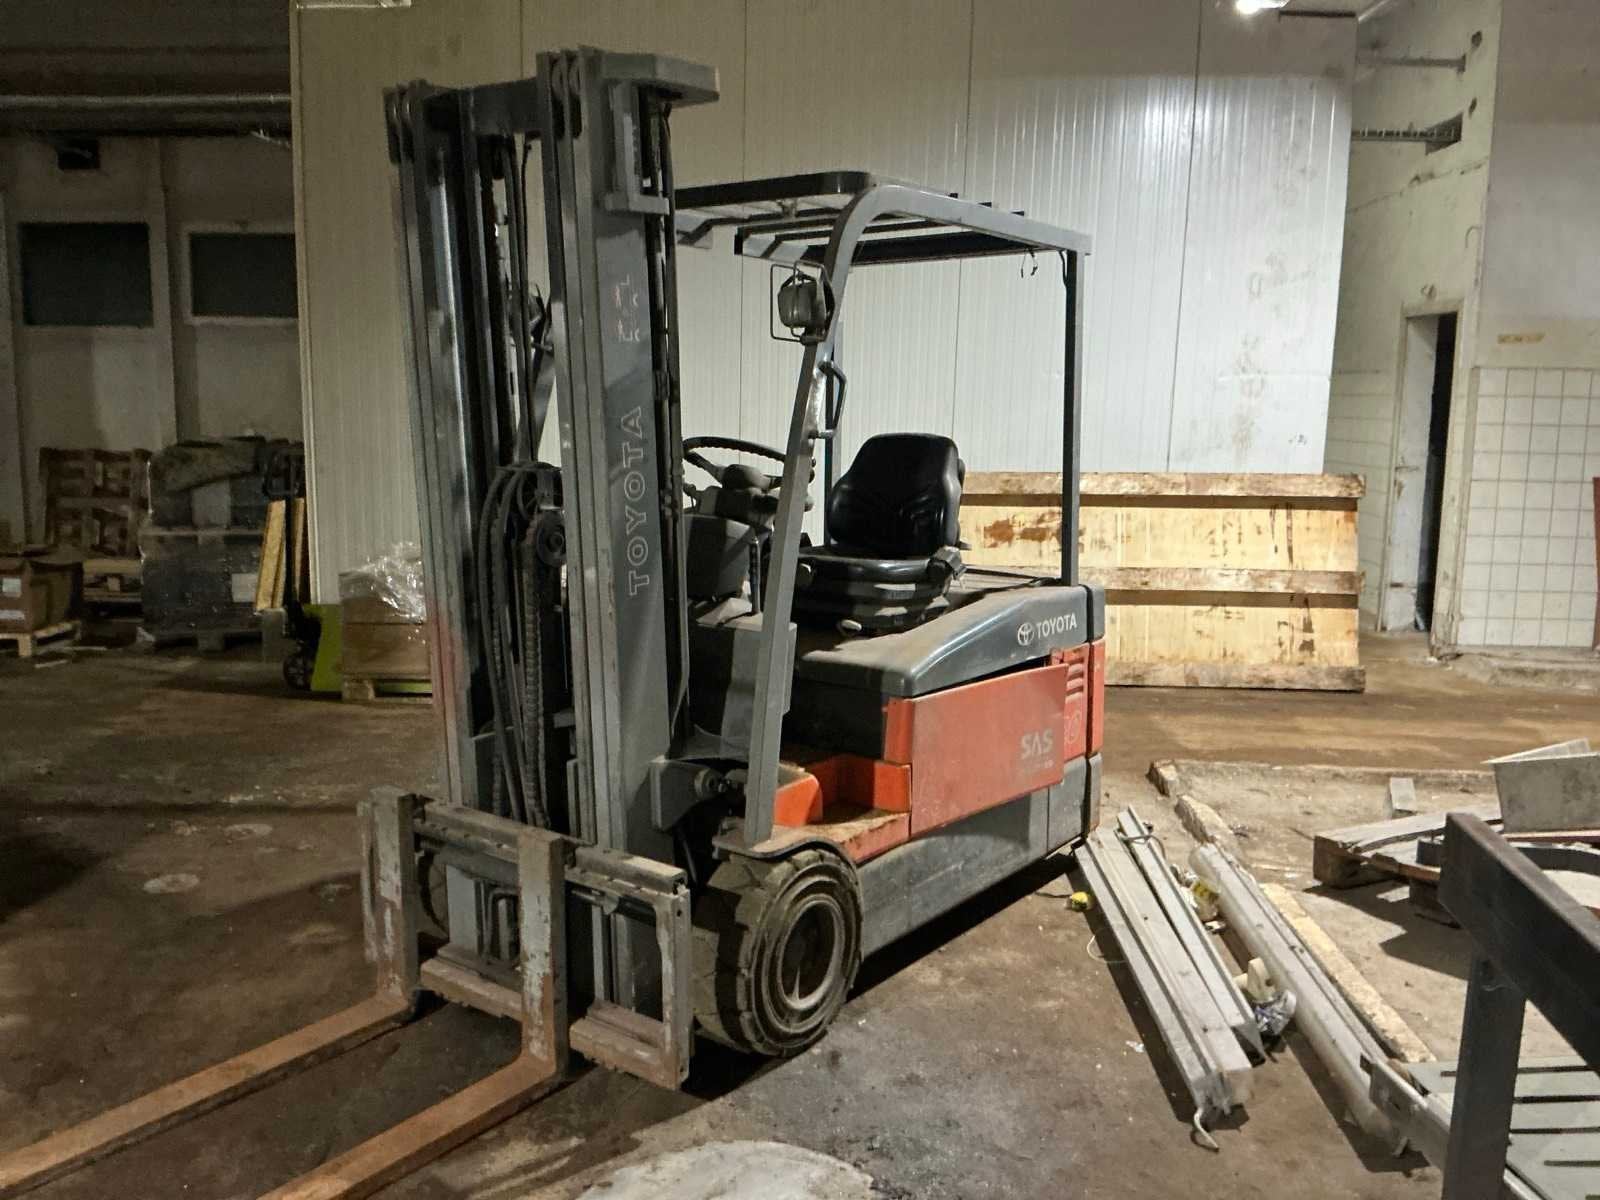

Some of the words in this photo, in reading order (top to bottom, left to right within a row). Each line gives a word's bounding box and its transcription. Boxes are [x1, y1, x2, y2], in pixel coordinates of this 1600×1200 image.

[620, 405, 650, 597] TOYOTA
[1036, 613, 1078, 639] TOYOTA
[1020, 728, 1054, 760] SAS
